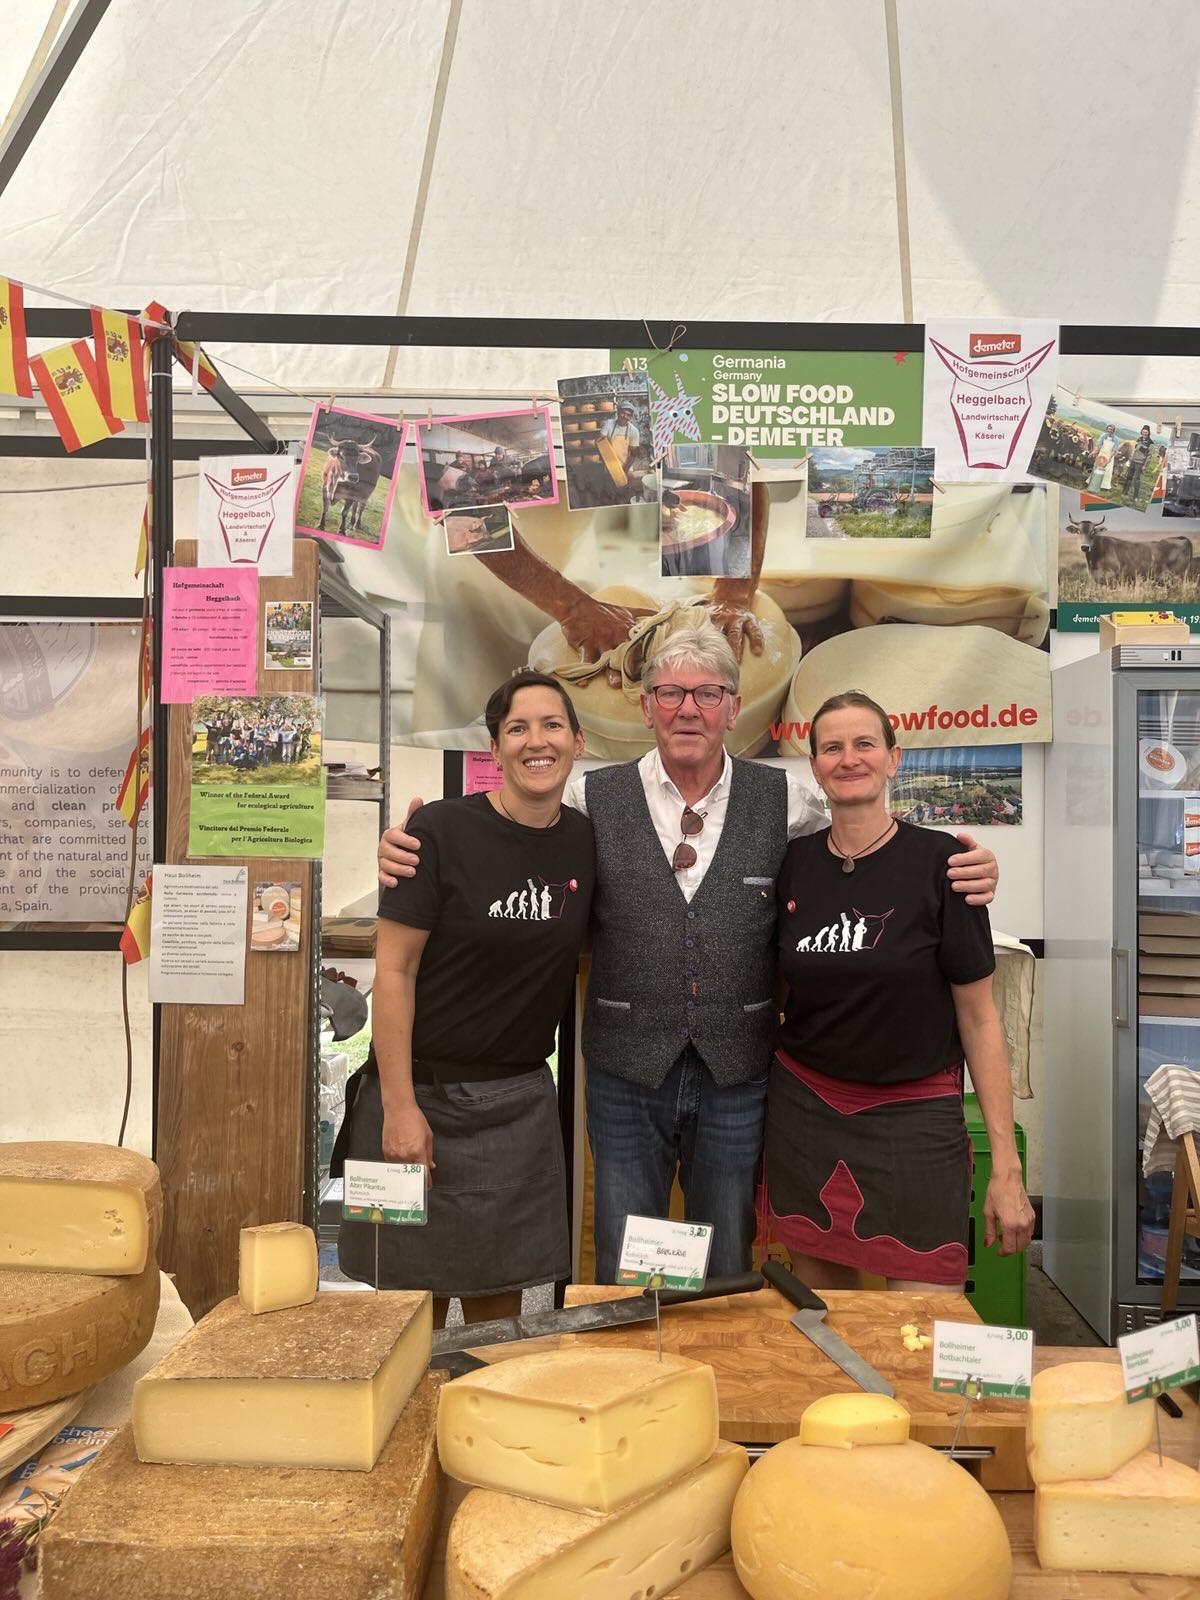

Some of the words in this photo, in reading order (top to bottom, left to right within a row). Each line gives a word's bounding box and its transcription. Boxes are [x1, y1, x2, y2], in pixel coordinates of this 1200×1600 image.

[973, 339, 1016, 353] demeter
[712, 355, 786, 369] Germania
[952, 359, 1032, 380] Hofgemeinschaft
[713, 370, 763, 382] Germany
[711, 383, 781, 403] SLOW
[786, 384, 854, 404] FOOD
[956, 394, 1026, 407] Heggelbach
[711, 405, 895, 426] DEUTSCHLAND
[961, 413, 1020, 422] Landwirtschaft
[727, 427, 844, 447] DEMETER
[975, 431, 1006, 440] Käserei
[233, 472, 264, 483] demeter
[219, 487, 274, 501] Hofgemeinschaft
[222, 510, 272, 520] Heggelbach
[172, 582, 225, 590] Hofgemeinschaft
[206, 595, 241, 603] Heggelbach
[1072, 614, 1100, 624] demete
[50, 767, 60, 778] is
[68, 767, 81, 778] to
[88, 766, 126, 778] defen
[11, 800, 35, 811] and
[51, 800, 87, 811] clean
[248, 802, 278, 810] ecological
[24, 818, 96, 830] companies,
[32, 835, 52, 845] are
[59, 834, 126, 845] committed
[16, 850, 29, 861] of
[33, 850, 54, 861] the
[57, 850, 102, 862] natural
[106, 850, 129, 862] and
[19, 867, 42, 878] and
[56, 867, 77, 878] the
[90, 867, 125, 878] social
[25, 883, 38, 895] of
[48, 883, 69, 895] the
[15, 901, 53, 913] Spain.
[402, 1164, 422, 1174] 3,80
[1006, 1329, 1029, 1341] 3,00
